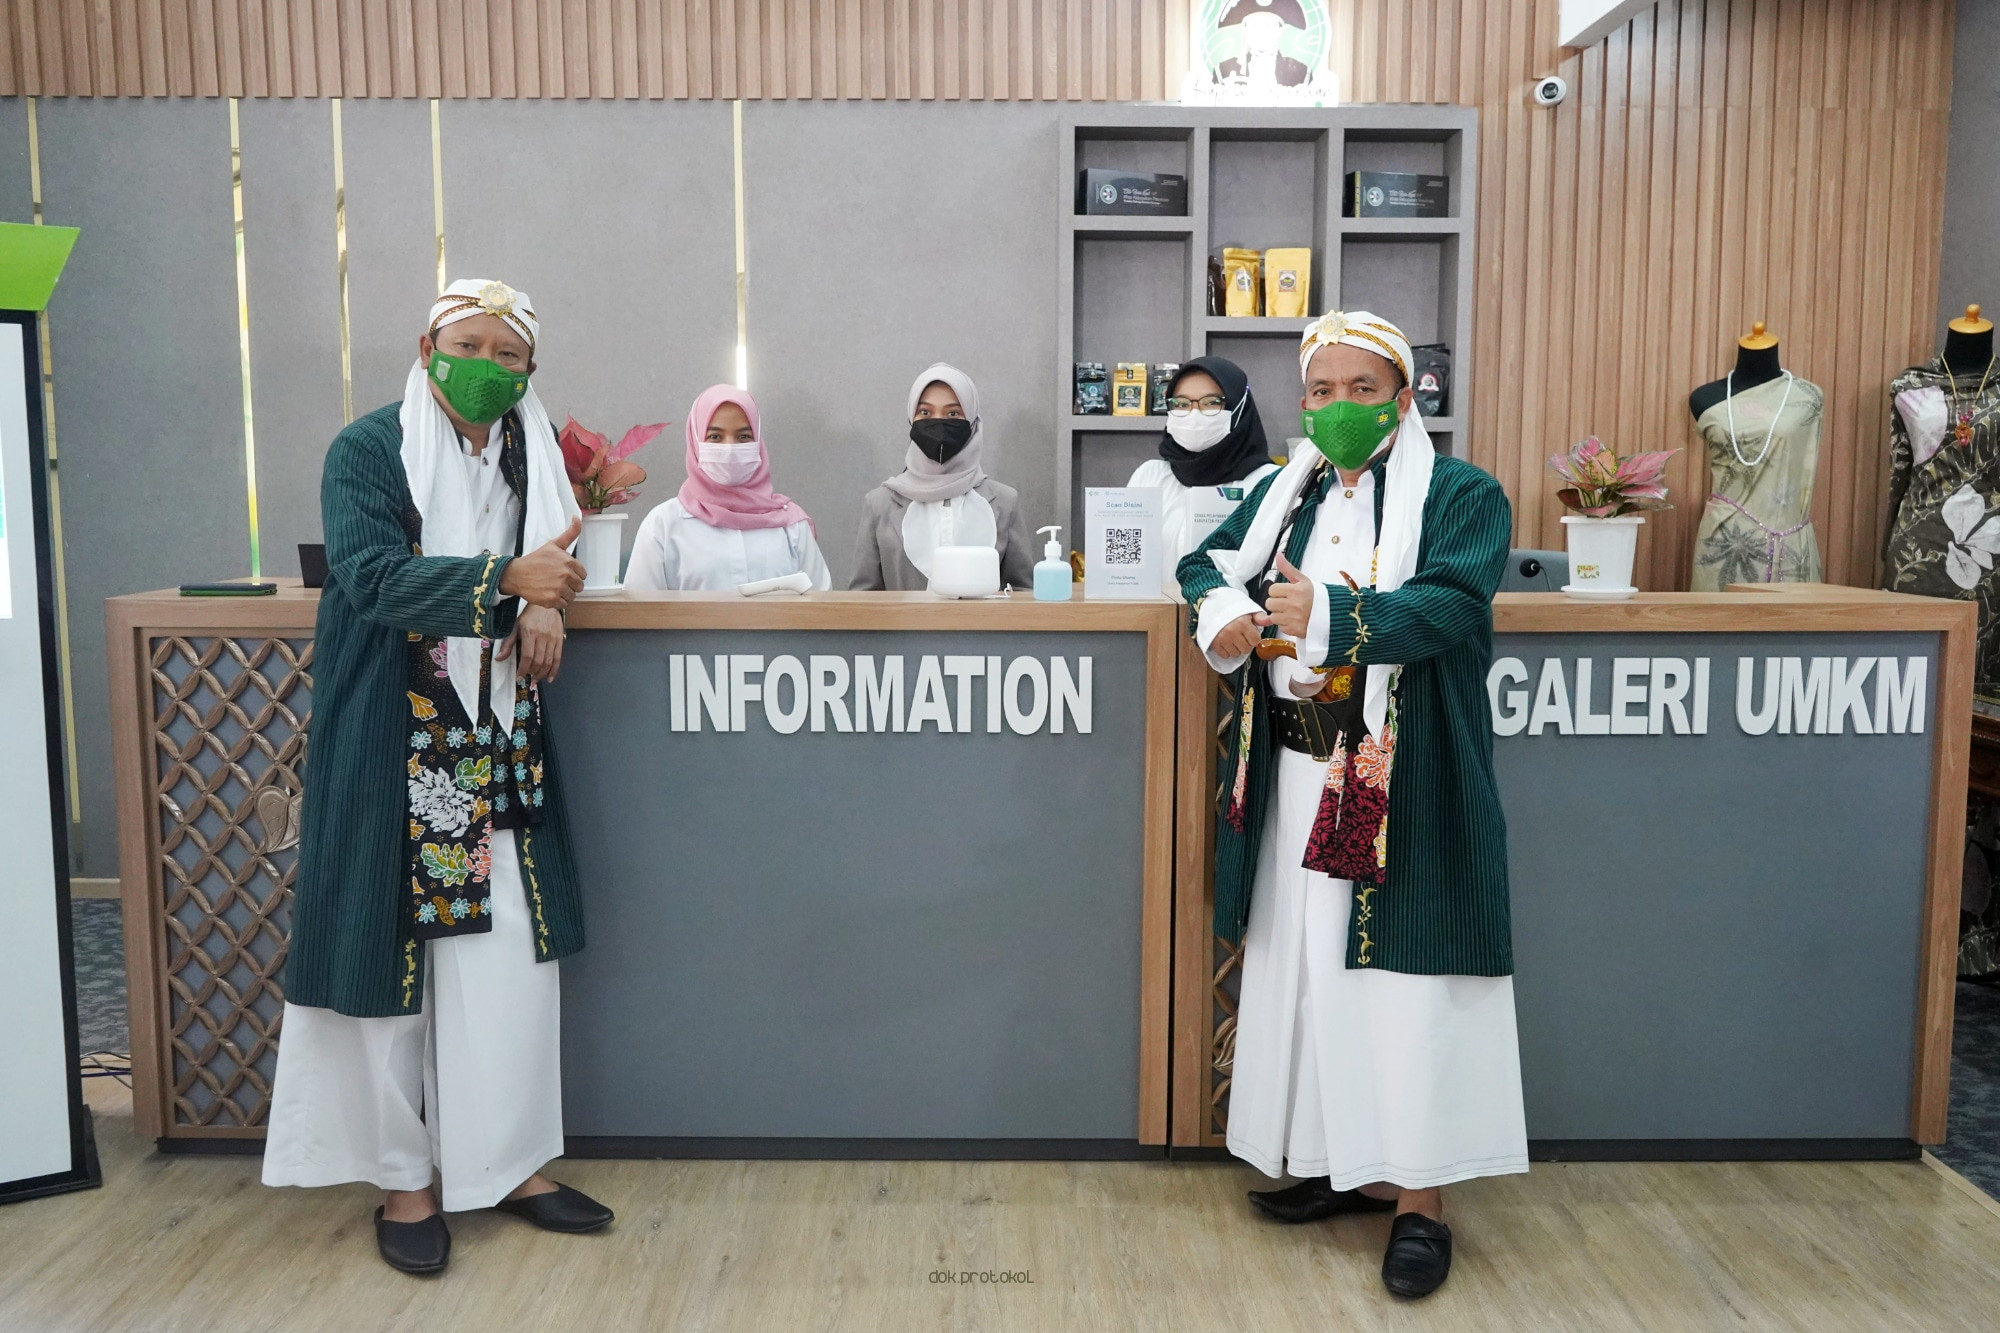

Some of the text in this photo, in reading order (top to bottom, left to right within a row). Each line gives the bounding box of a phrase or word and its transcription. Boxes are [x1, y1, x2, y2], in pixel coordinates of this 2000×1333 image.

[669, 654, 1093, 735] INFORMATION
[1486, 656, 1928, 736] GALERI UMKM
